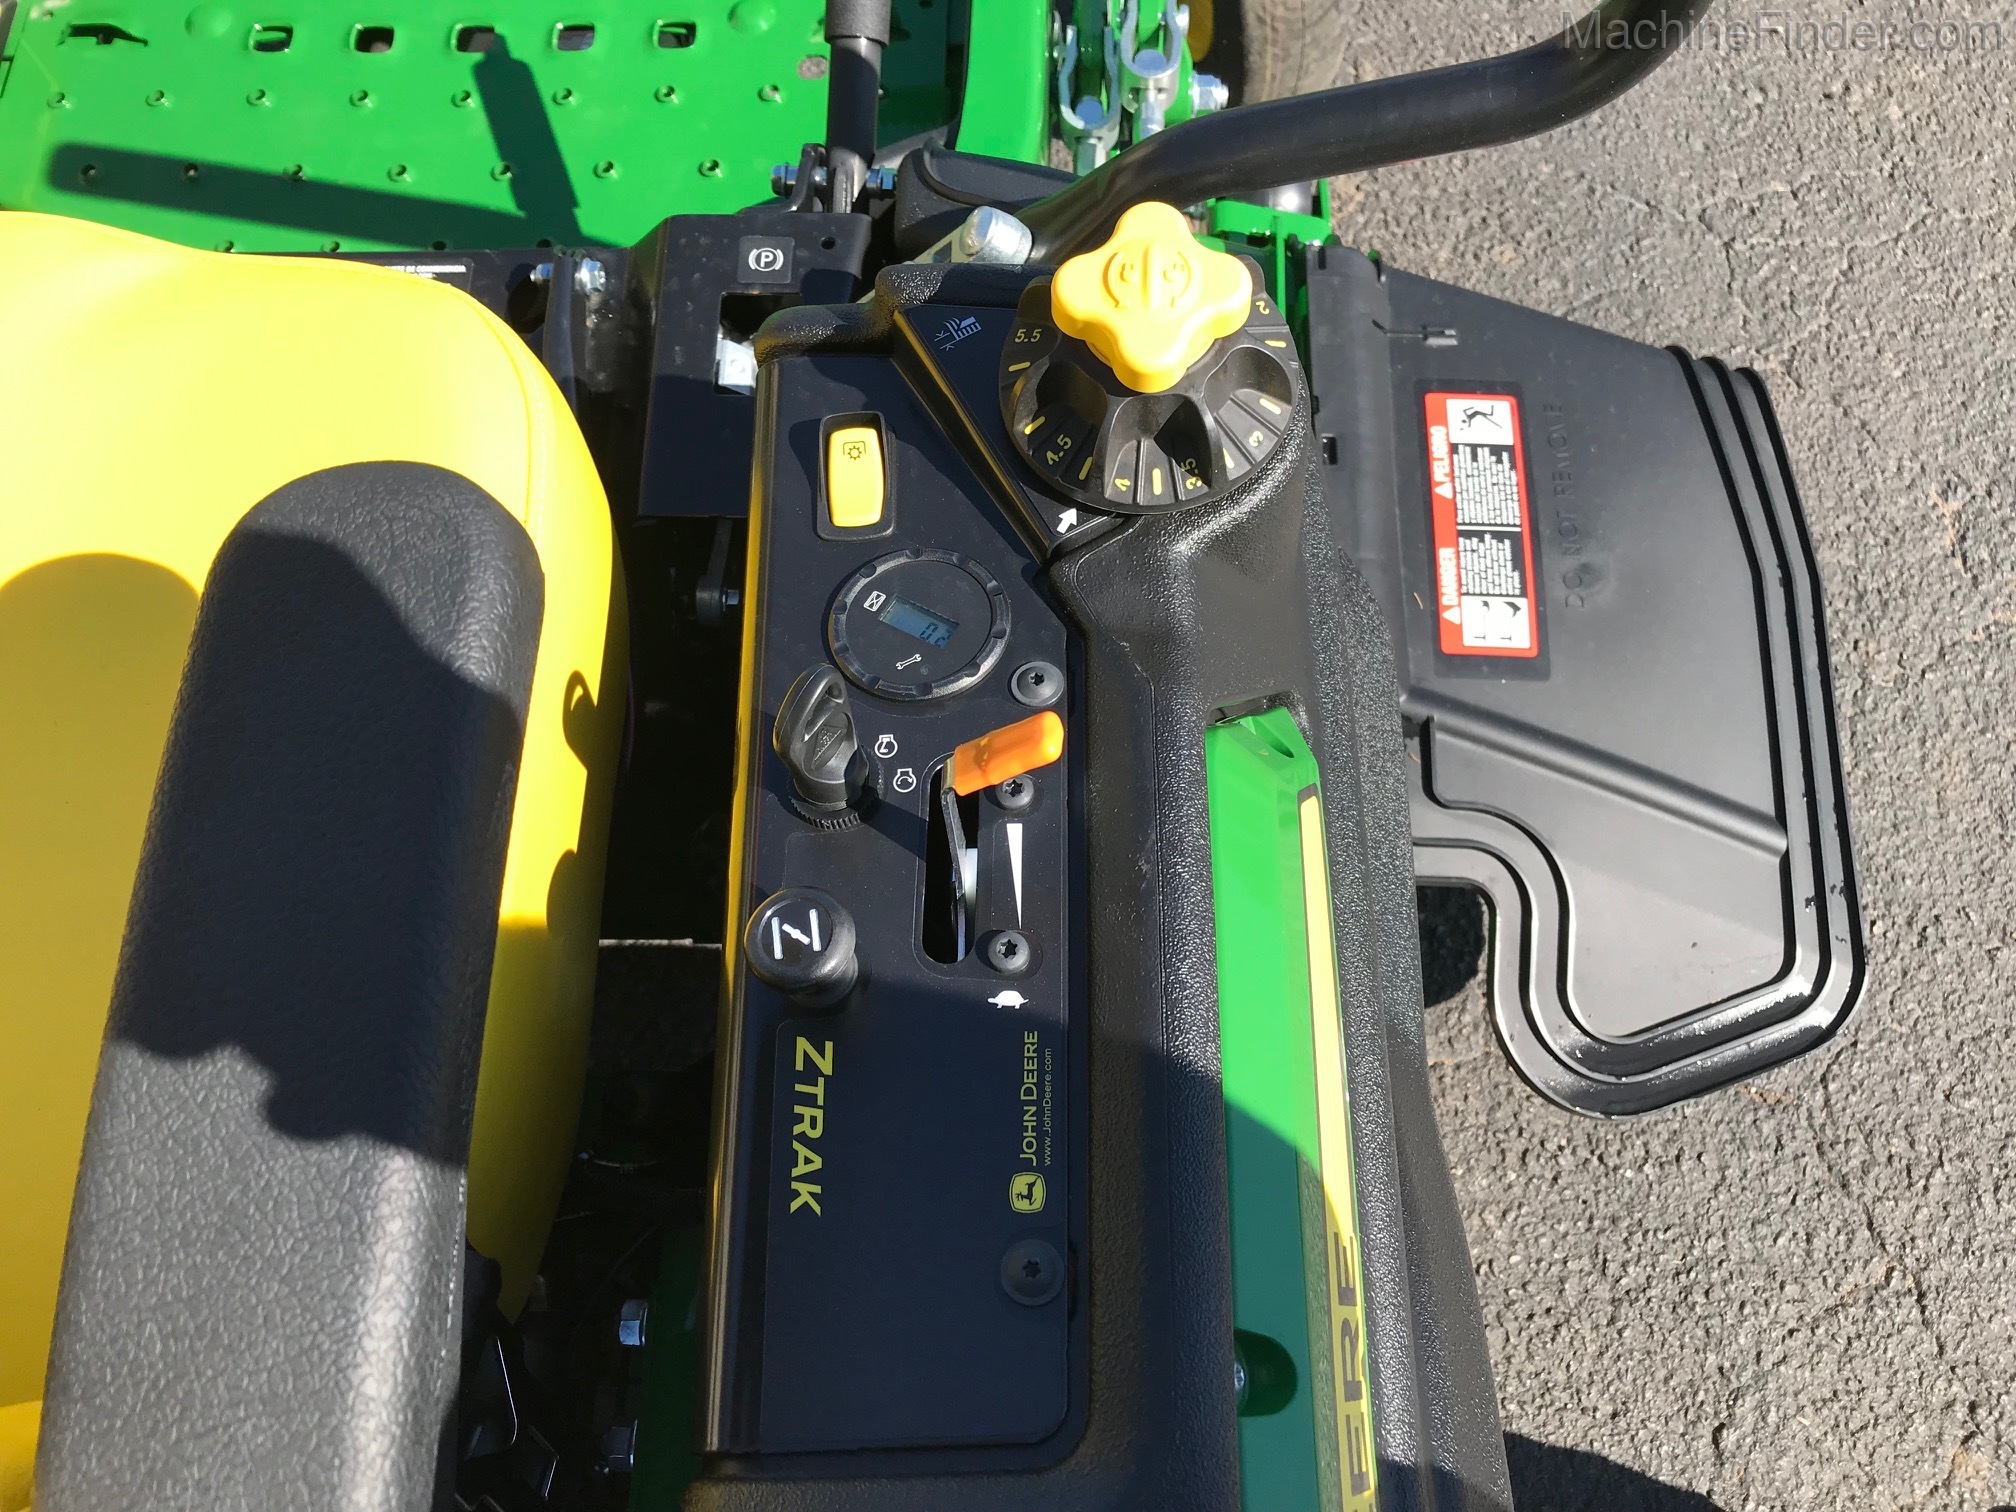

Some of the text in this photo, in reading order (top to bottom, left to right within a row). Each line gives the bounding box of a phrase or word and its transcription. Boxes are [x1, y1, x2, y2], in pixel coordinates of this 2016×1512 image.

[1014, 328, 1042, 343] 5.5
[1045, 433, 1072, 466] 4.5
[1248, 430, 1264, 447] 3
[1429, 425, 1451, 482] PELIGRO
[1113, 477, 1131, 491] 4
[1438, 547, 1459, 606] DANGER
[789, 1035, 834, 1217] ZTRAK
[1019, 1030, 1039, 1167] JOHN DEERE
[1042, 1048, 1052, 1167] www.JohnDeere.com
[1333, 1231, 1374, 1512] ERE
